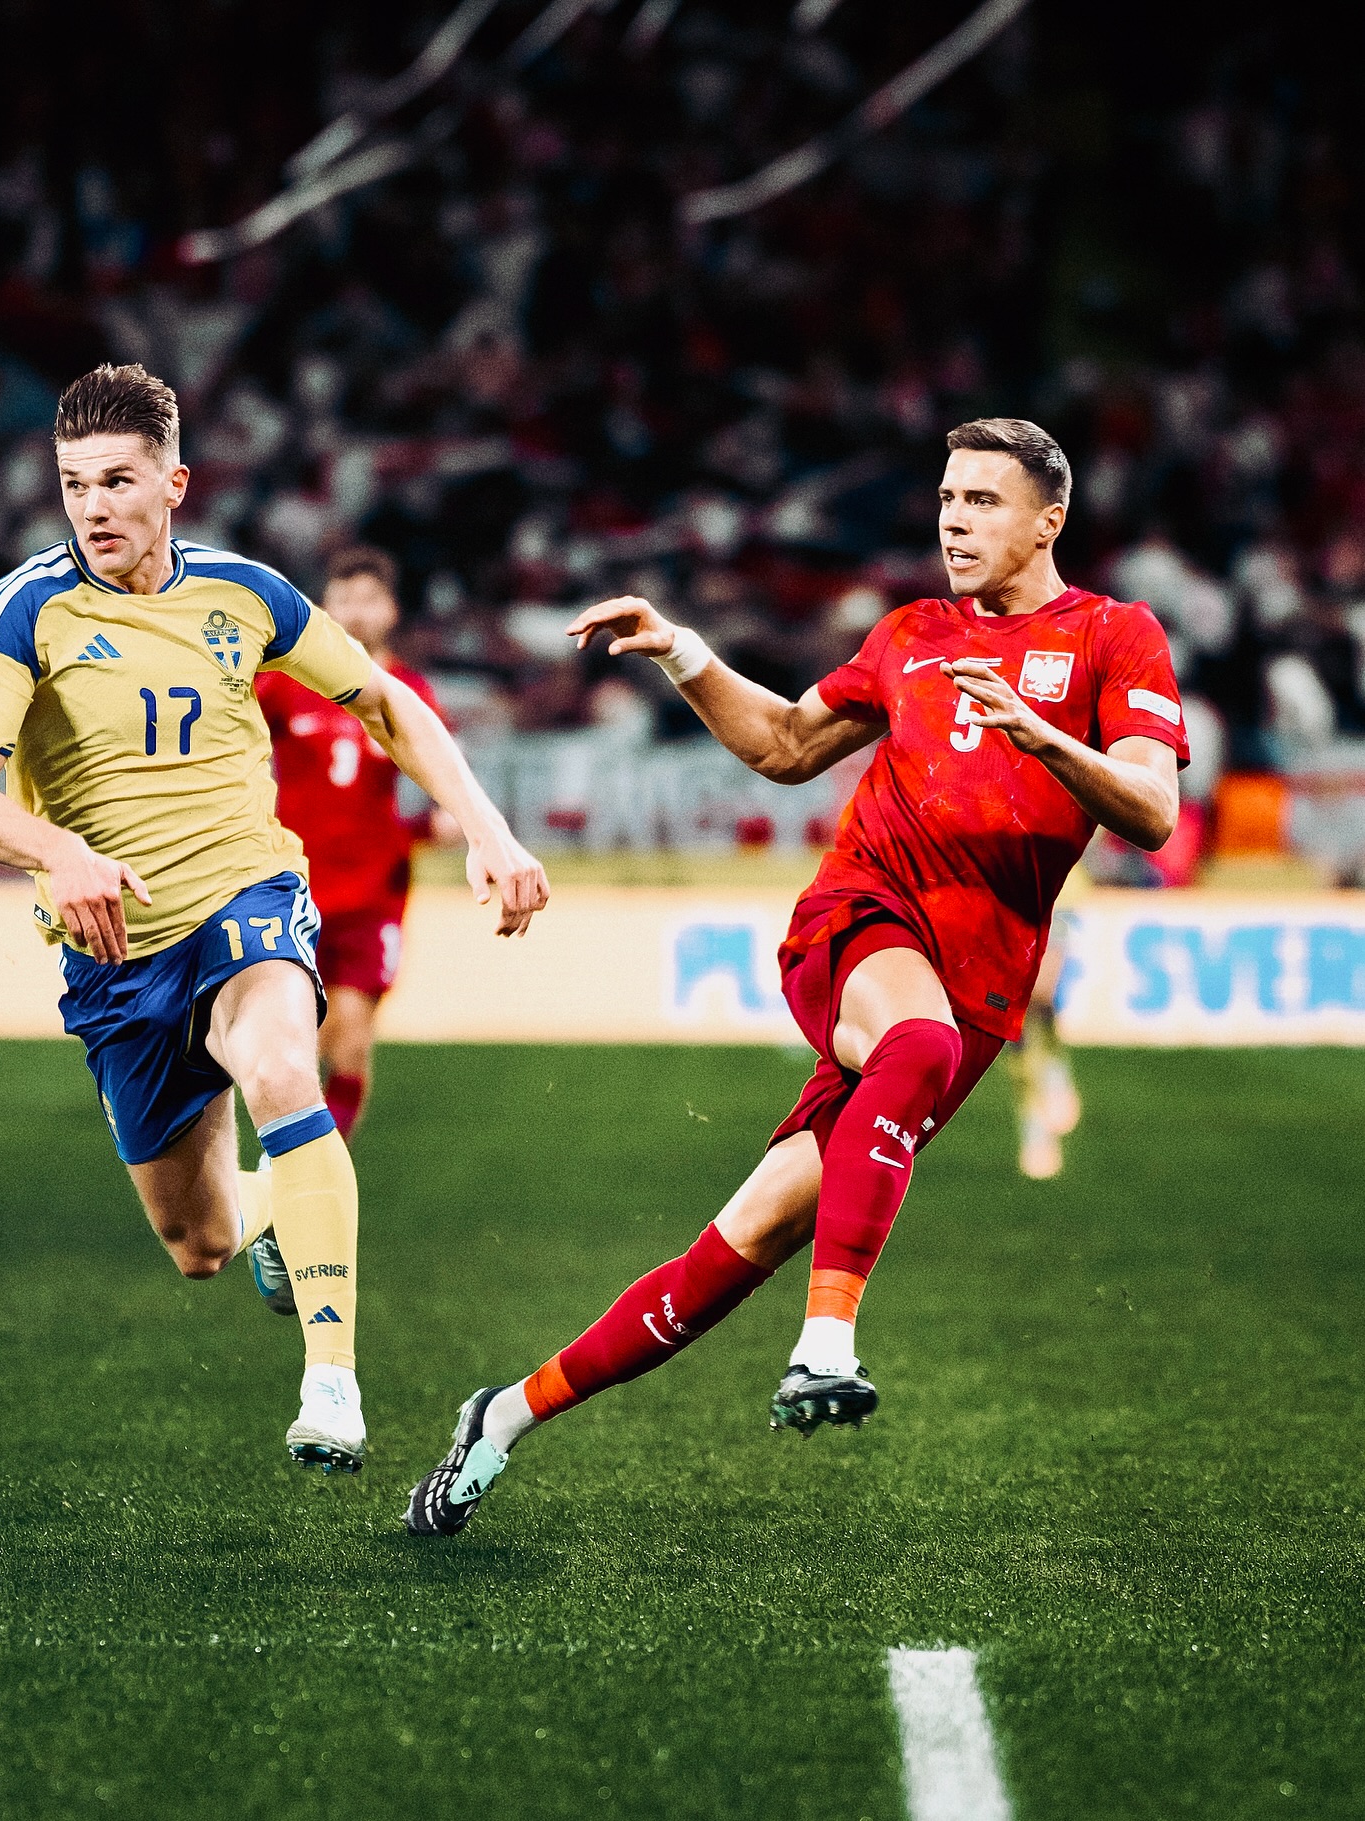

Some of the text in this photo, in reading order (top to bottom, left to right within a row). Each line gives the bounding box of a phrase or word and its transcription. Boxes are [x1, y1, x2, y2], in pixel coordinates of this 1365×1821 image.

[139, 686, 203, 756] 17
[949, 690, 984, 753] 5
[220, 916, 283, 961] 17
[1125, 922, 1365, 1013] SVER
[294, 1263, 349, 1281] SVERIGE
